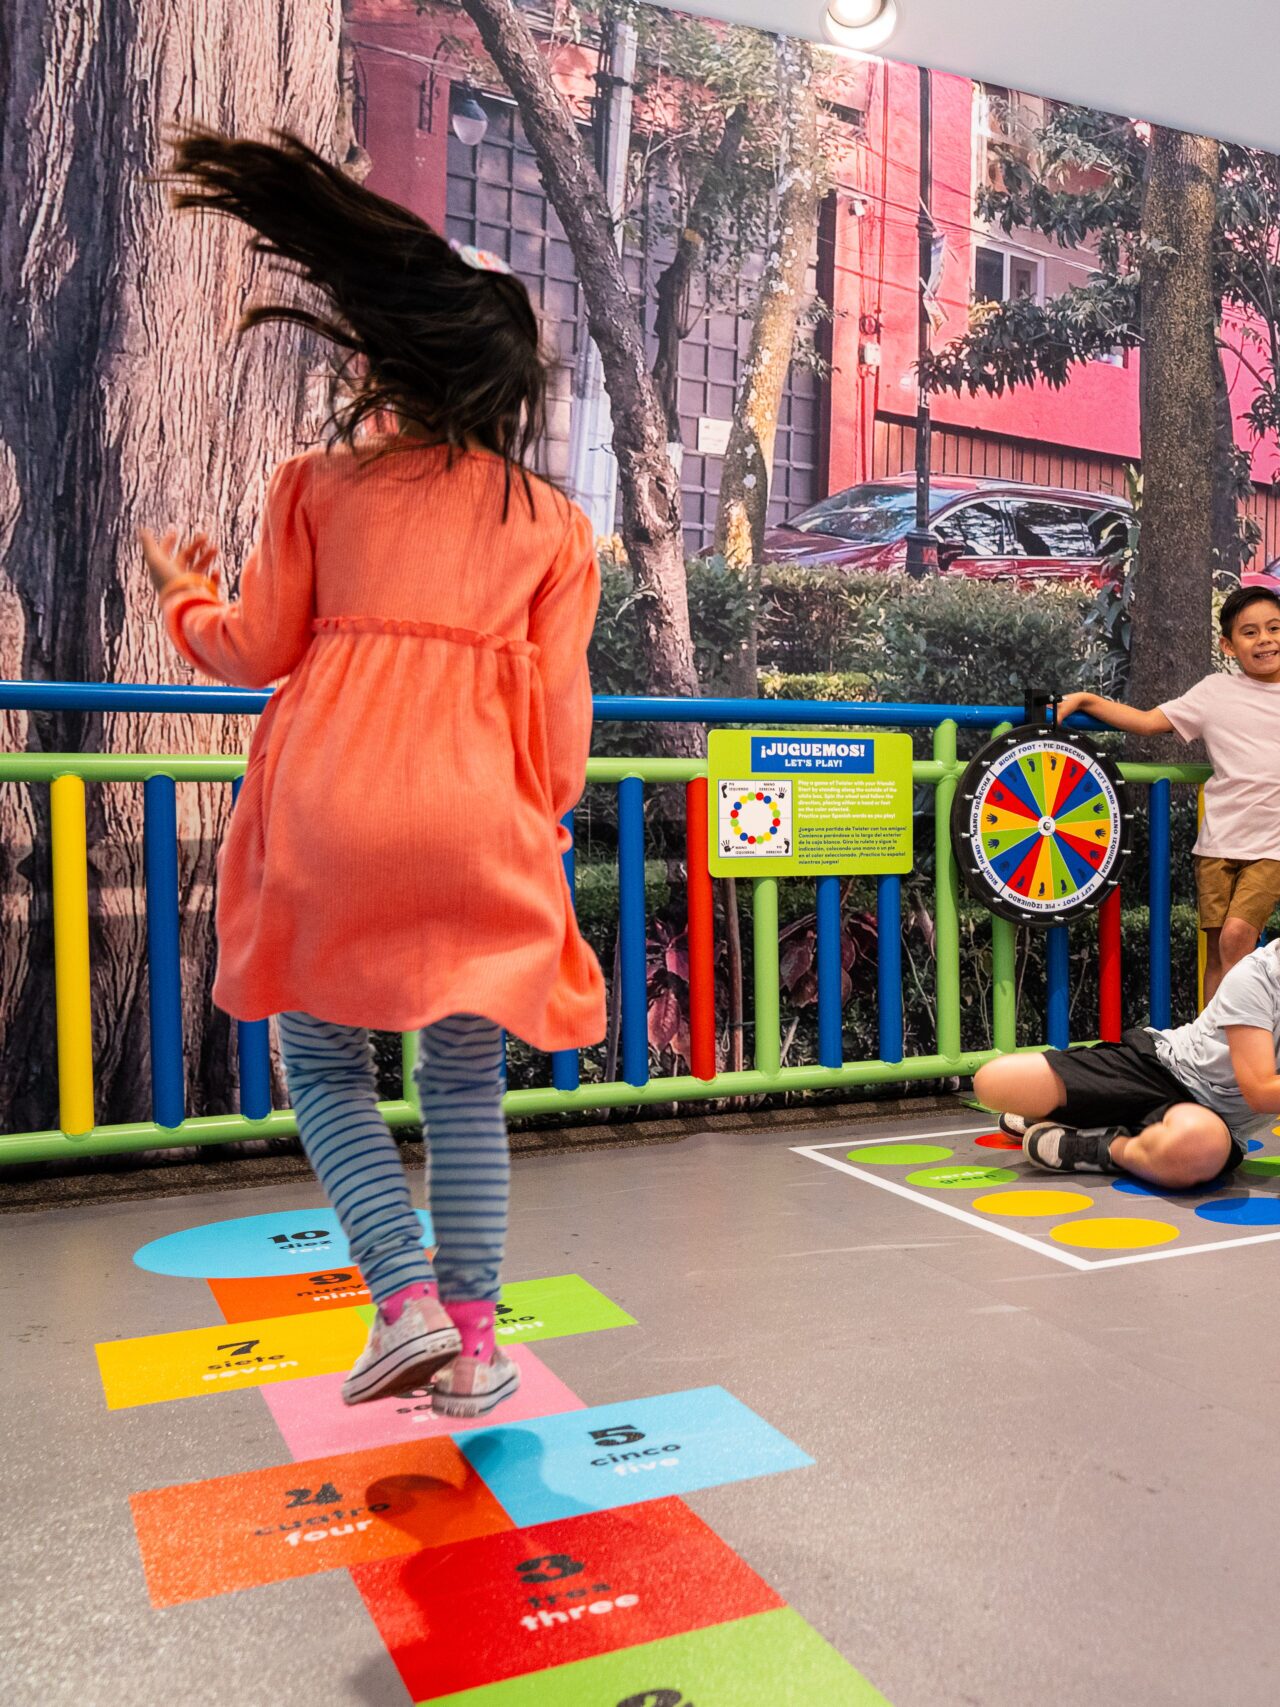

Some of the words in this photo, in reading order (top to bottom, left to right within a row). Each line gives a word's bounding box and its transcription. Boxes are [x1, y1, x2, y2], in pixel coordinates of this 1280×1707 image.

[761, 743, 865, 758] ¡JUGUEMOS!
[998, 751, 1017, 766] RIGHT
[1018, 744, 1036, 754] FOOT
[1056, 744, 1085, 761] DERECHO
[785, 759, 812, 767] LET'S
[816, 760, 842, 768] PLAY!
[974, 776, 991, 810] DERECHA
[1094, 768, 1107, 784] LEFT
[1105, 785, 1115, 804] HAND
[975, 844, 985, 865] HAND
[1101, 837, 1117, 874] IZQUIERDA
[983, 866, 998, 886] RIGHT
[1081, 883, 1095, 896] LEFT
[1008, 893, 1043, 909] IZQUIERDO
[1063, 895, 1080, 906] FOOT
[267, 1230, 330, 1244] 10
[279, 1240, 332, 1249] diez
[288, 1245, 330, 1254] ten
[308, 1273, 352, 1285] 9
[296, 1284, 368, 1296] nuev
[313, 1289, 371, 1302] nine
[496, 1316, 535, 1326] ho
[497, 1321, 544, 1335] ght
[217, 1340, 260, 1356] 7
[208, 1355, 285, 1370] siete
[202, 1361, 298, 1381] seven
[396, 1404, 433, 1414] se
[412, 1411, 439, 1423] si
[588, 1424, 646, 1446] 5
[590, 1444, 681, 1466] cinco
[614, 1458, 679, 1477] five
[255, 1503, 390, 1536] cuatro
[285, 1519, 373, 1546] four
[515, 1554, 585, 1584] 3
[528, 1583, 612, 1609] tres
[520, 1594, 639, 1631] three
